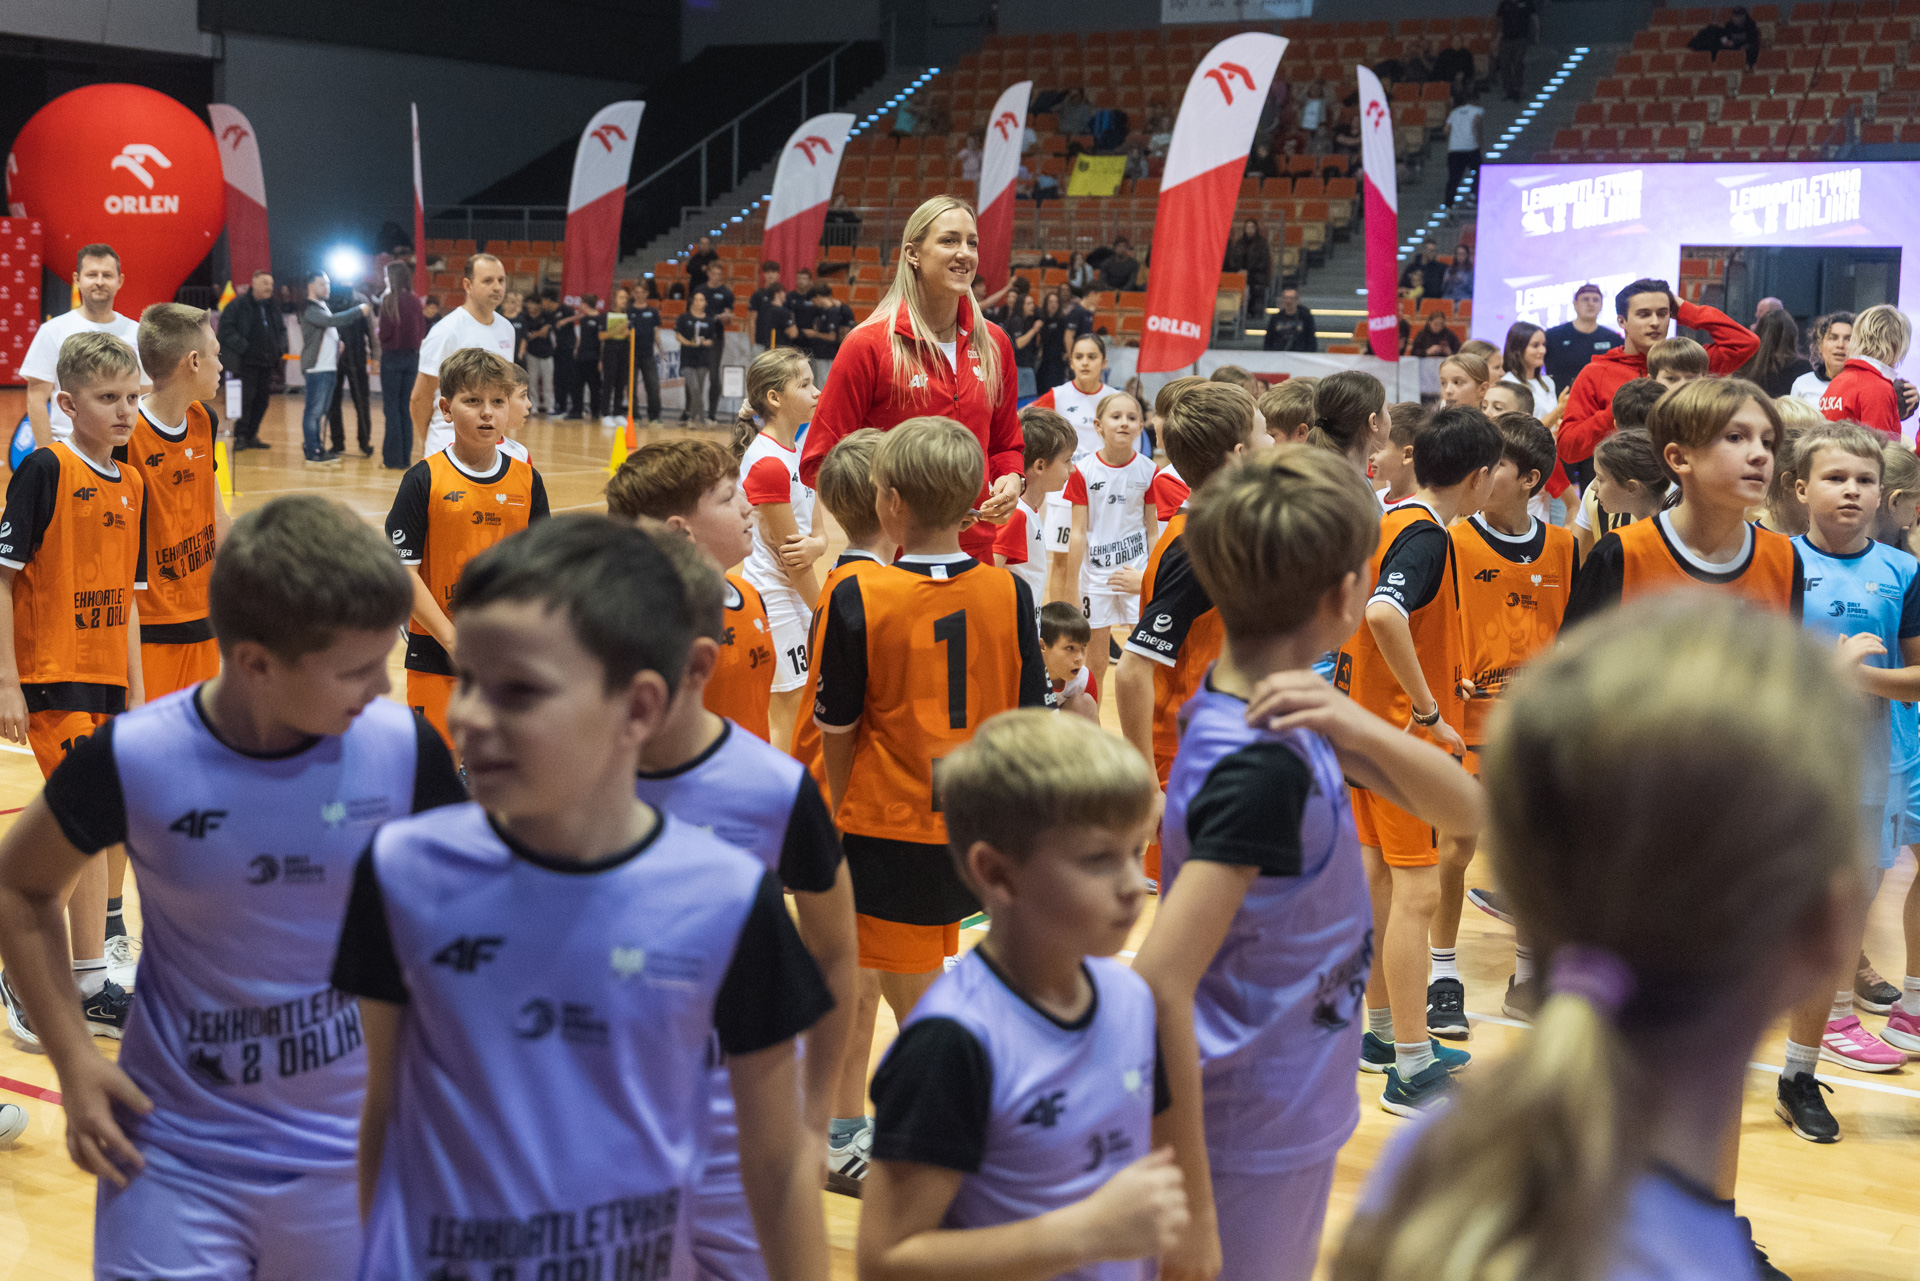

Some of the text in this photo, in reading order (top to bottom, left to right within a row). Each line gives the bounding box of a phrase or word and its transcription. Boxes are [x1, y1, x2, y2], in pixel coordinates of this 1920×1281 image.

[104, 195, 179, 214] ORLEN
[564, 294, 605, 309] ORN
[1147, 314, 1201, 339] ORLEN
[1819, 396, 1843, 411] OLSKA
[145, 452, 165, 467] 4F
[73, 487, 98, 501] 4F
[1089, 481, 1106, 491] 4F
[443, 490, 467, 502] 4F
[1057, 526, 1071, 545] 16
[0, 542, 14, 553] rga
[397, 548, 413, 558] rga
[1474, 568, 1500, 582] 4F
[1136, 630, 1173, 651] Energa
[787, 644, 808, 675] 13
[934, 608, 967, 729] 1
[169, 809, 229, 839] 4F
[432, 935, 504, 974] 4F
[188, 988, 344, 1043] LEKKOATLET
[279, 1005, 362, 1078] ORLIK
[1020, 1089, 1067, 1128] 4F
